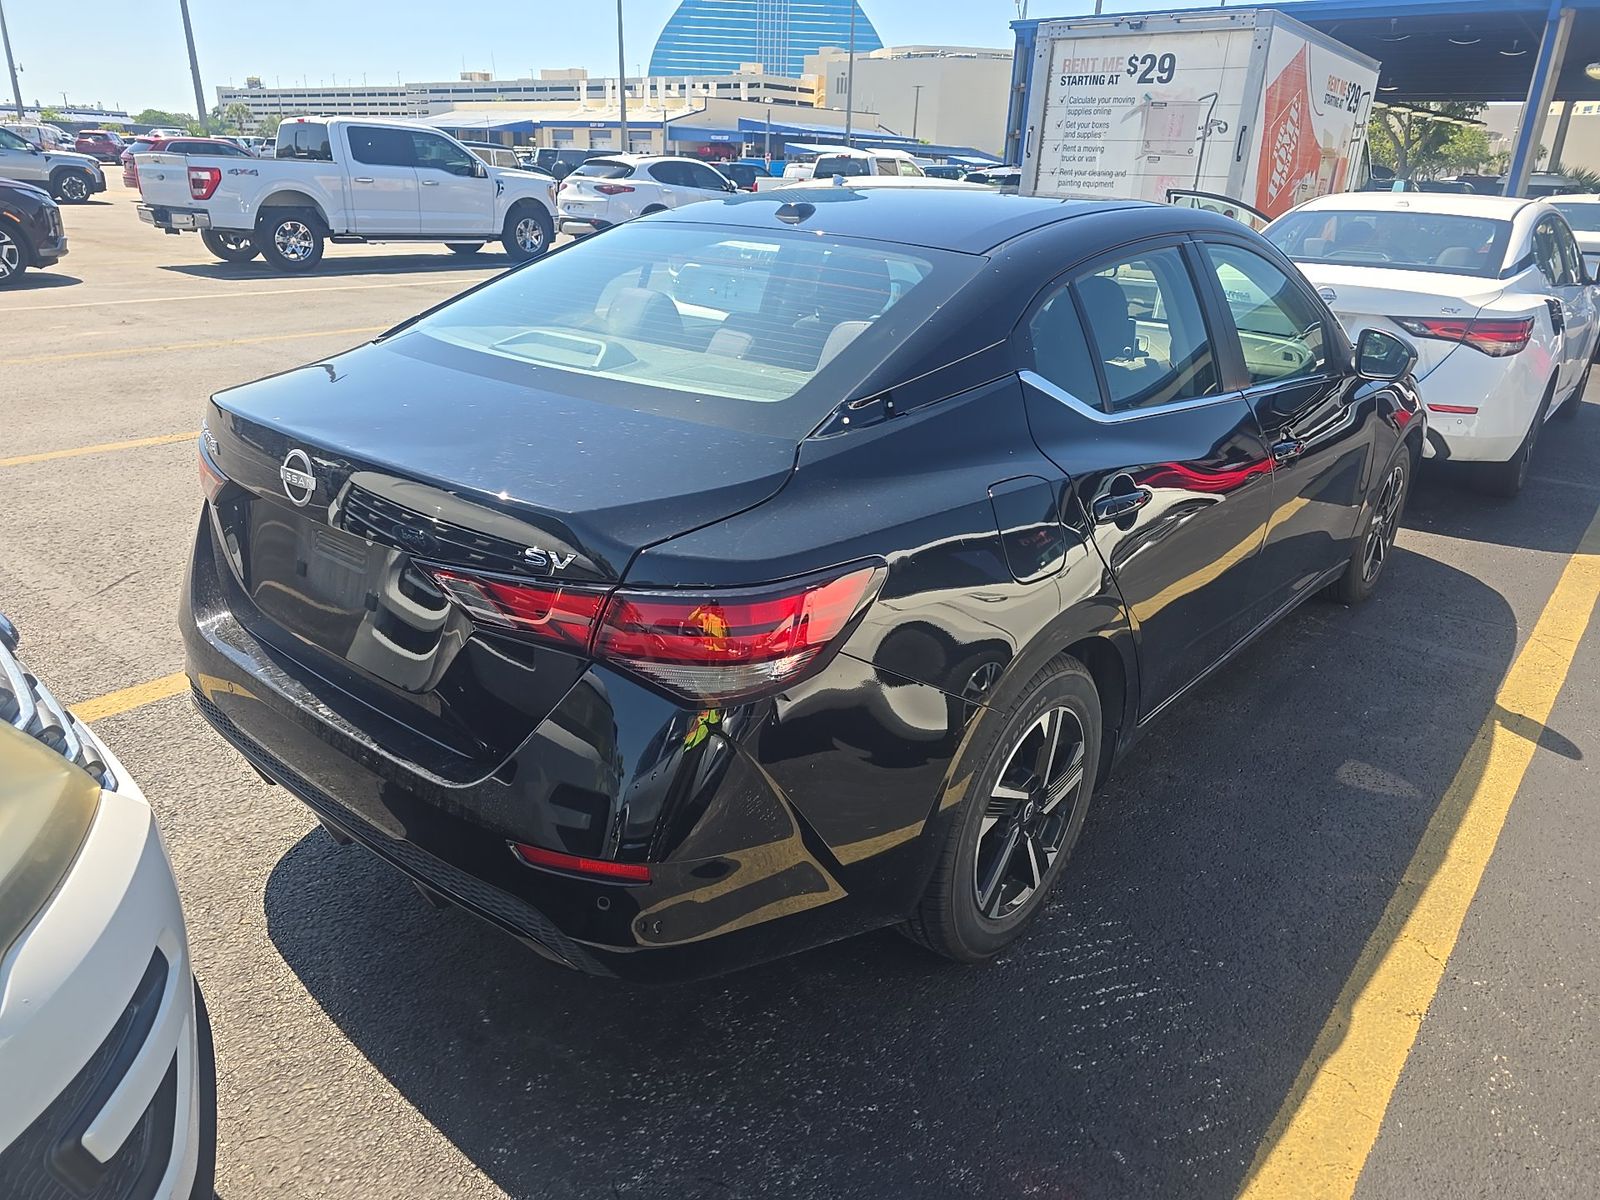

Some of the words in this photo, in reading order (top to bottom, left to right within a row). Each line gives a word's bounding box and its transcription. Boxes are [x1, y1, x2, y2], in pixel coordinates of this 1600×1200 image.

[1062, 58, 1099, 74] RENT
[1102, 57, 1125, 72] ME
[1126, 53, 1177, 84] $29
[1060, 75, 1106, 87] STARTING
[1107, 74, 1121, 85] AT
[1068, 95, 1097, 104] Calculate
[1097, 96, 1112, 106] your
[1112, 95, 1136, 106] moving
[1345, 81, 1362, 114] $29
[1067, 107, 1092, 117] supplies
[1092, 107, 1112, 116] online
[1065, 120, 1077, 129] Get
[1077, 121, 1091, 130] your
[1091, 121, 1110, 129] boxes
[1064, 130, 1076, 138] and
[1062, 144, 1077, 153] Rent
[1082, 144, 1105, 154] moving
[1061, 154, 1076, 162] truck
[1059, 168, 1073, 176] Rent
[1073, 170, 1088, 178] your
[1088, 169, 1114, 178] cleaning
[1114, 170, 1127, 178] and
[1057, 179, 1082, 189] painting
[1082, 180, 1115, 189] equipment
[282, 467, 316, 490] ISSAN
[524, 546, 577, 570] SV
